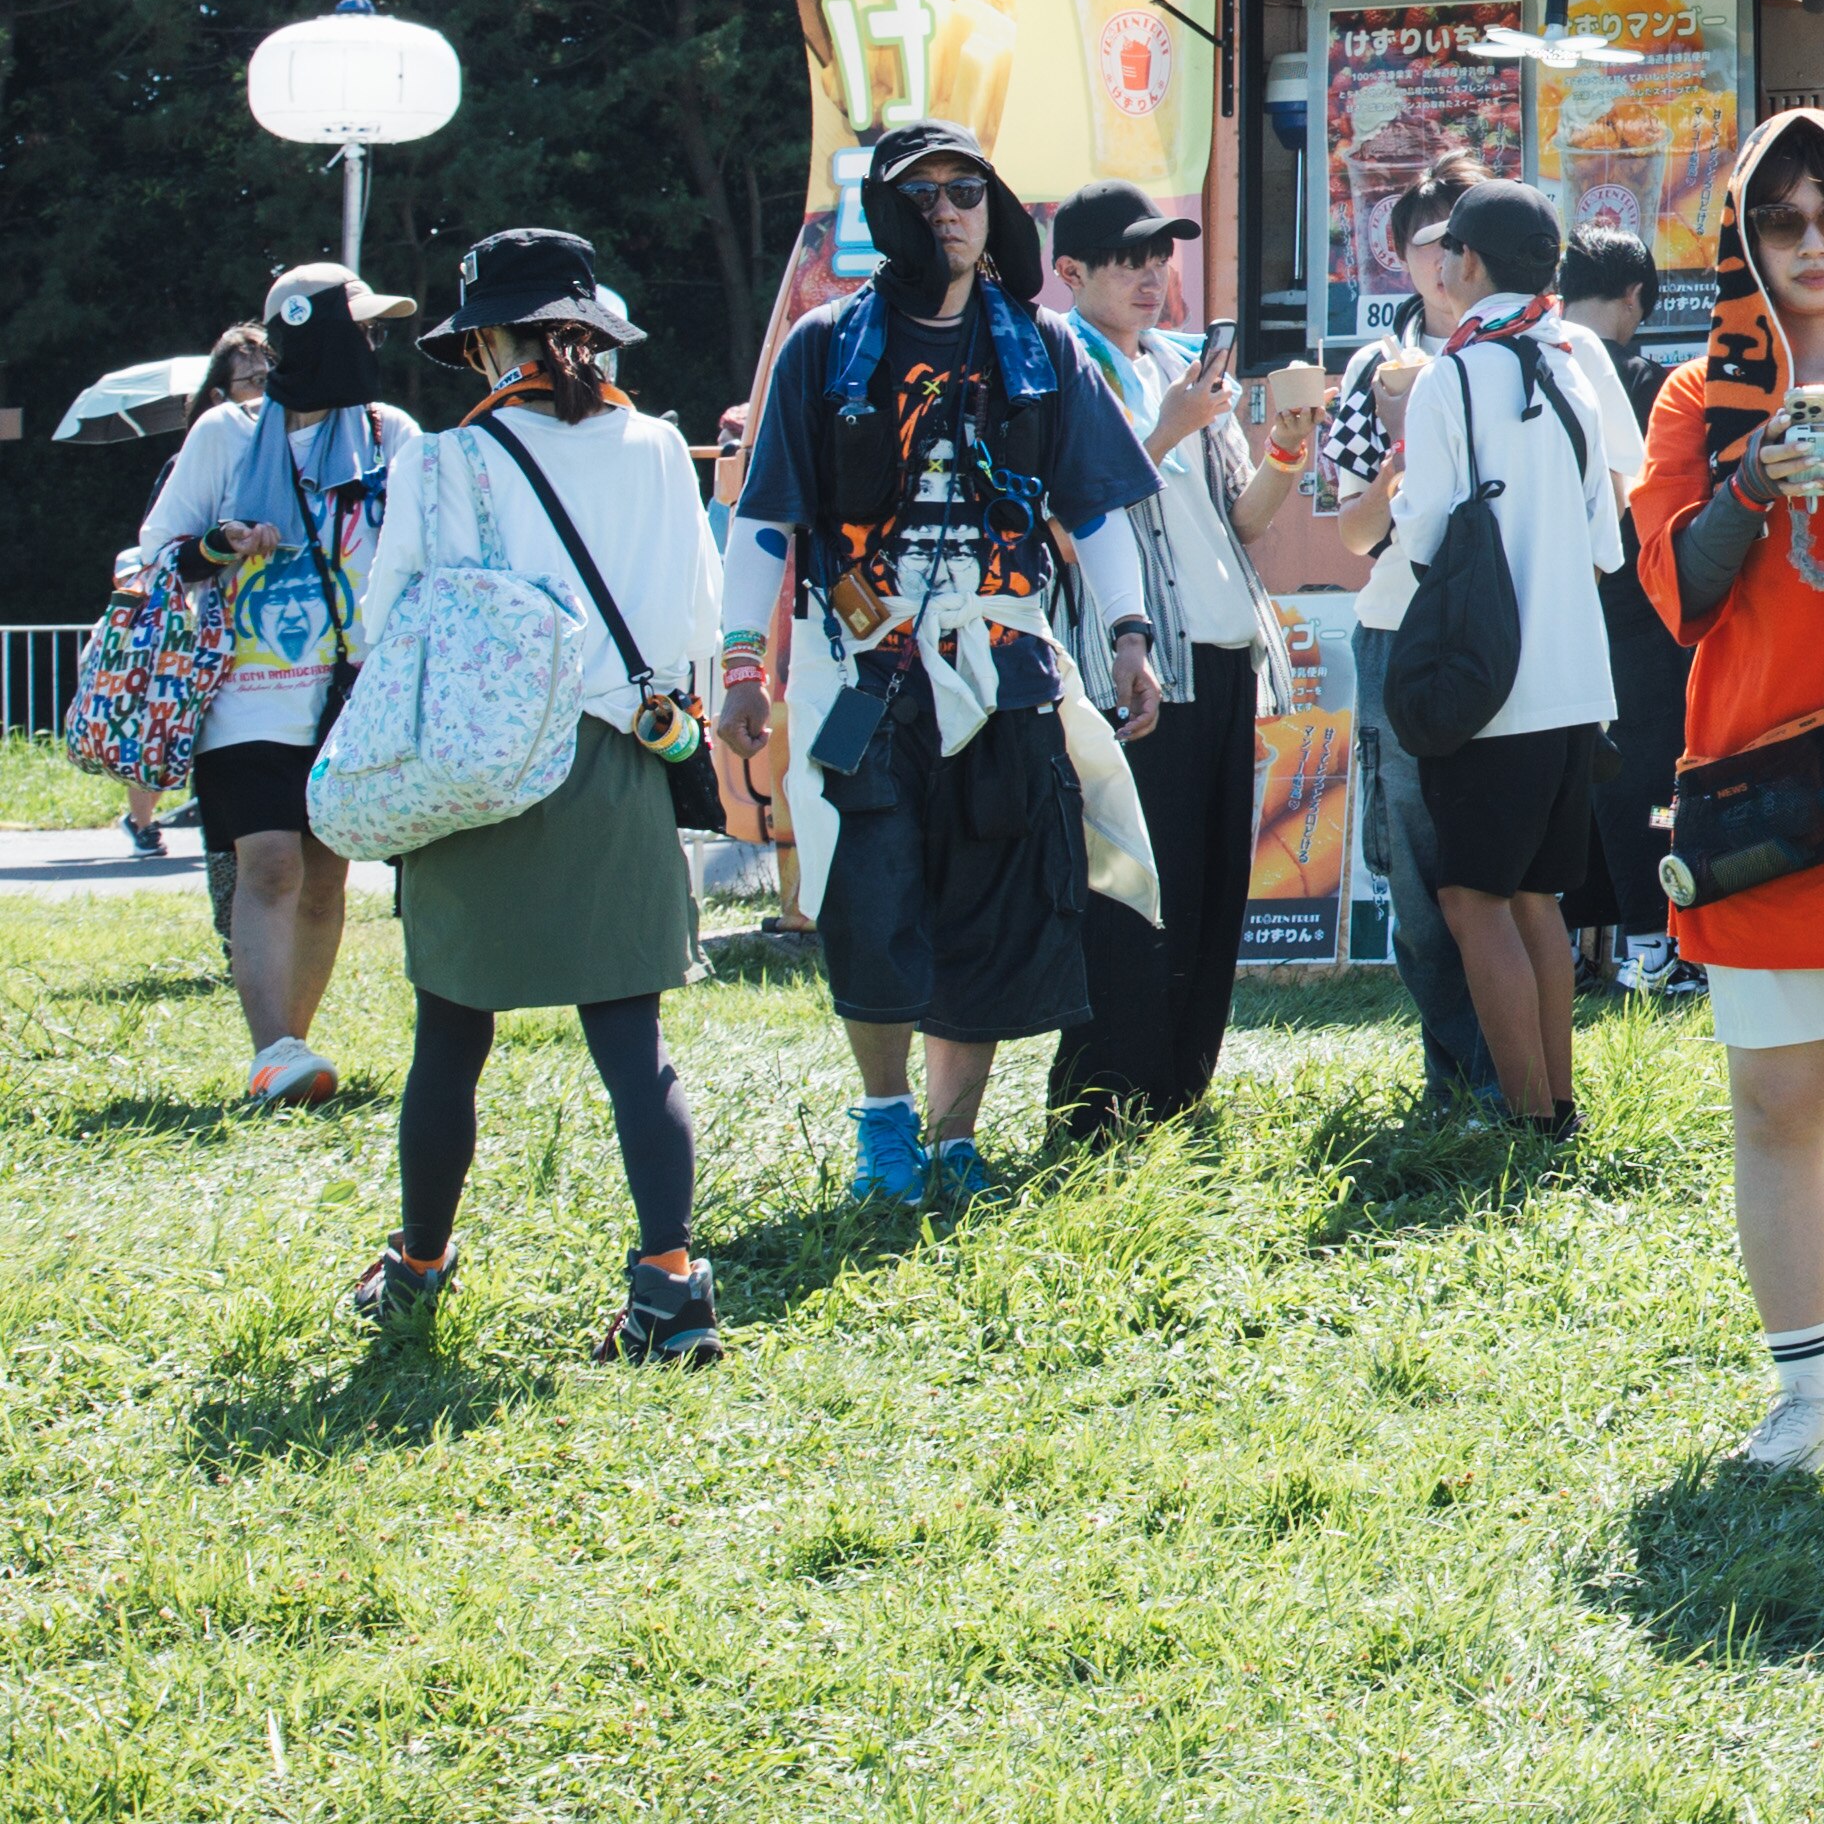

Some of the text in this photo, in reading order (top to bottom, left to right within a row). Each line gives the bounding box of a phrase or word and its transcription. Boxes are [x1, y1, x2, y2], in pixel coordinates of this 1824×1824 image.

[1345, 24, 1503, 58] けずりいち
[1664, 295, 1714, 312] けずりん
[1717, 782, 1749, 800] NEWS
[1255, 927, 1312, 944] けずりん
